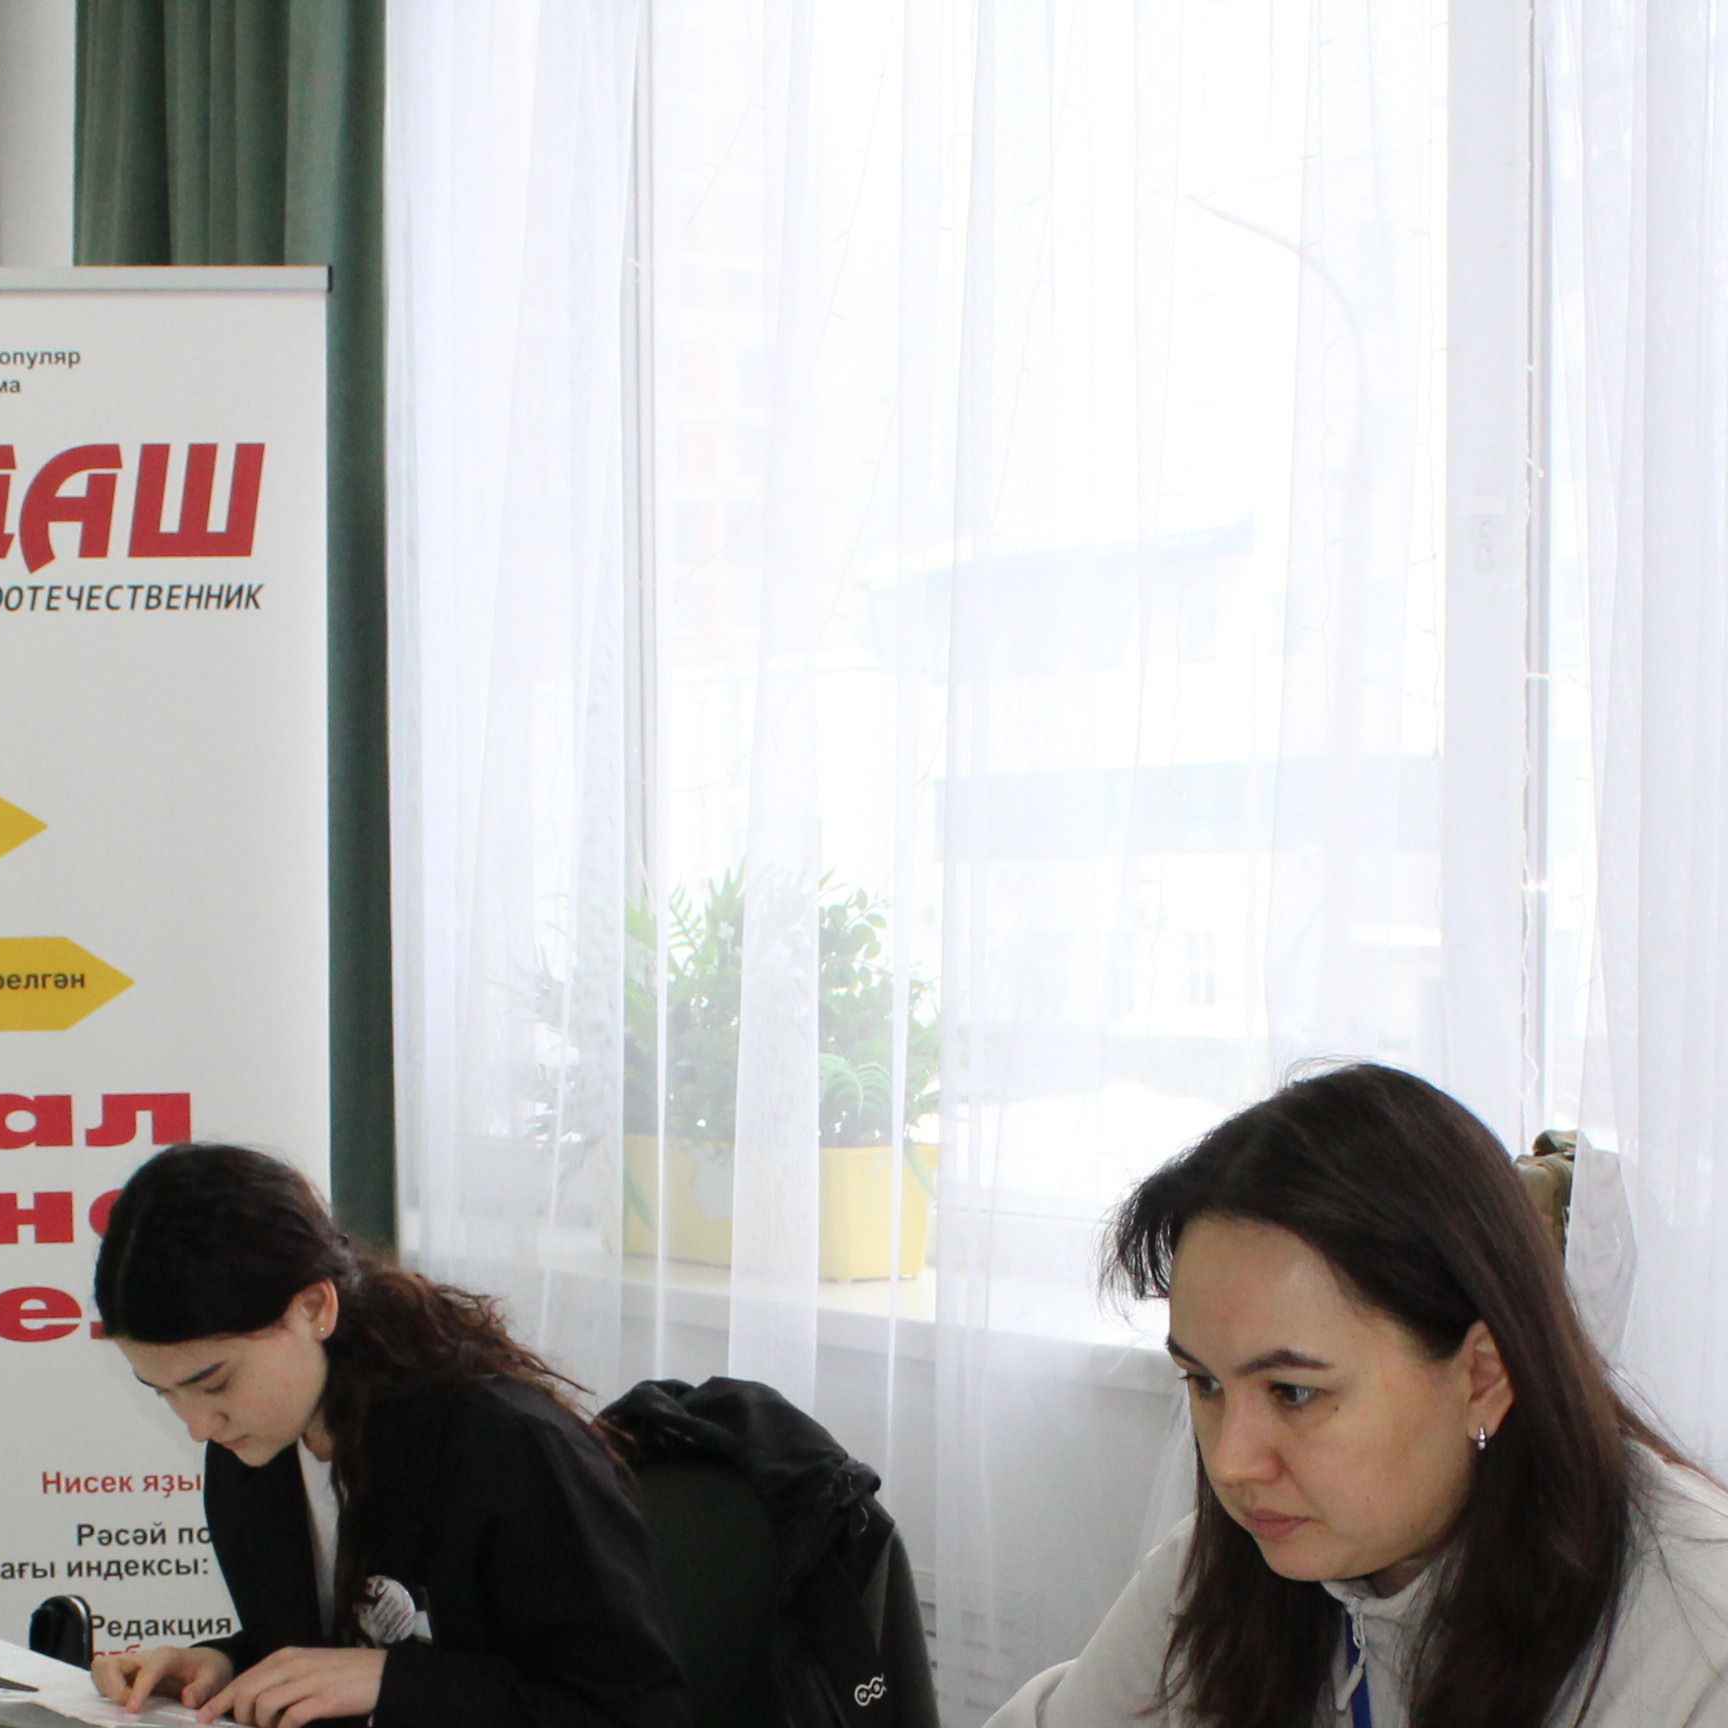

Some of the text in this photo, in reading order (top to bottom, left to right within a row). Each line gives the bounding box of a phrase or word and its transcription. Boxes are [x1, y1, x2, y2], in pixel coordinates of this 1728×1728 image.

[42, 1471, 133, 1495] Нисек
[76, 1522, 167, 1547] Рәсәй
[66, 1558, 208, 1581] индексы:
[91, 1615, 232, 1641] Редакция
